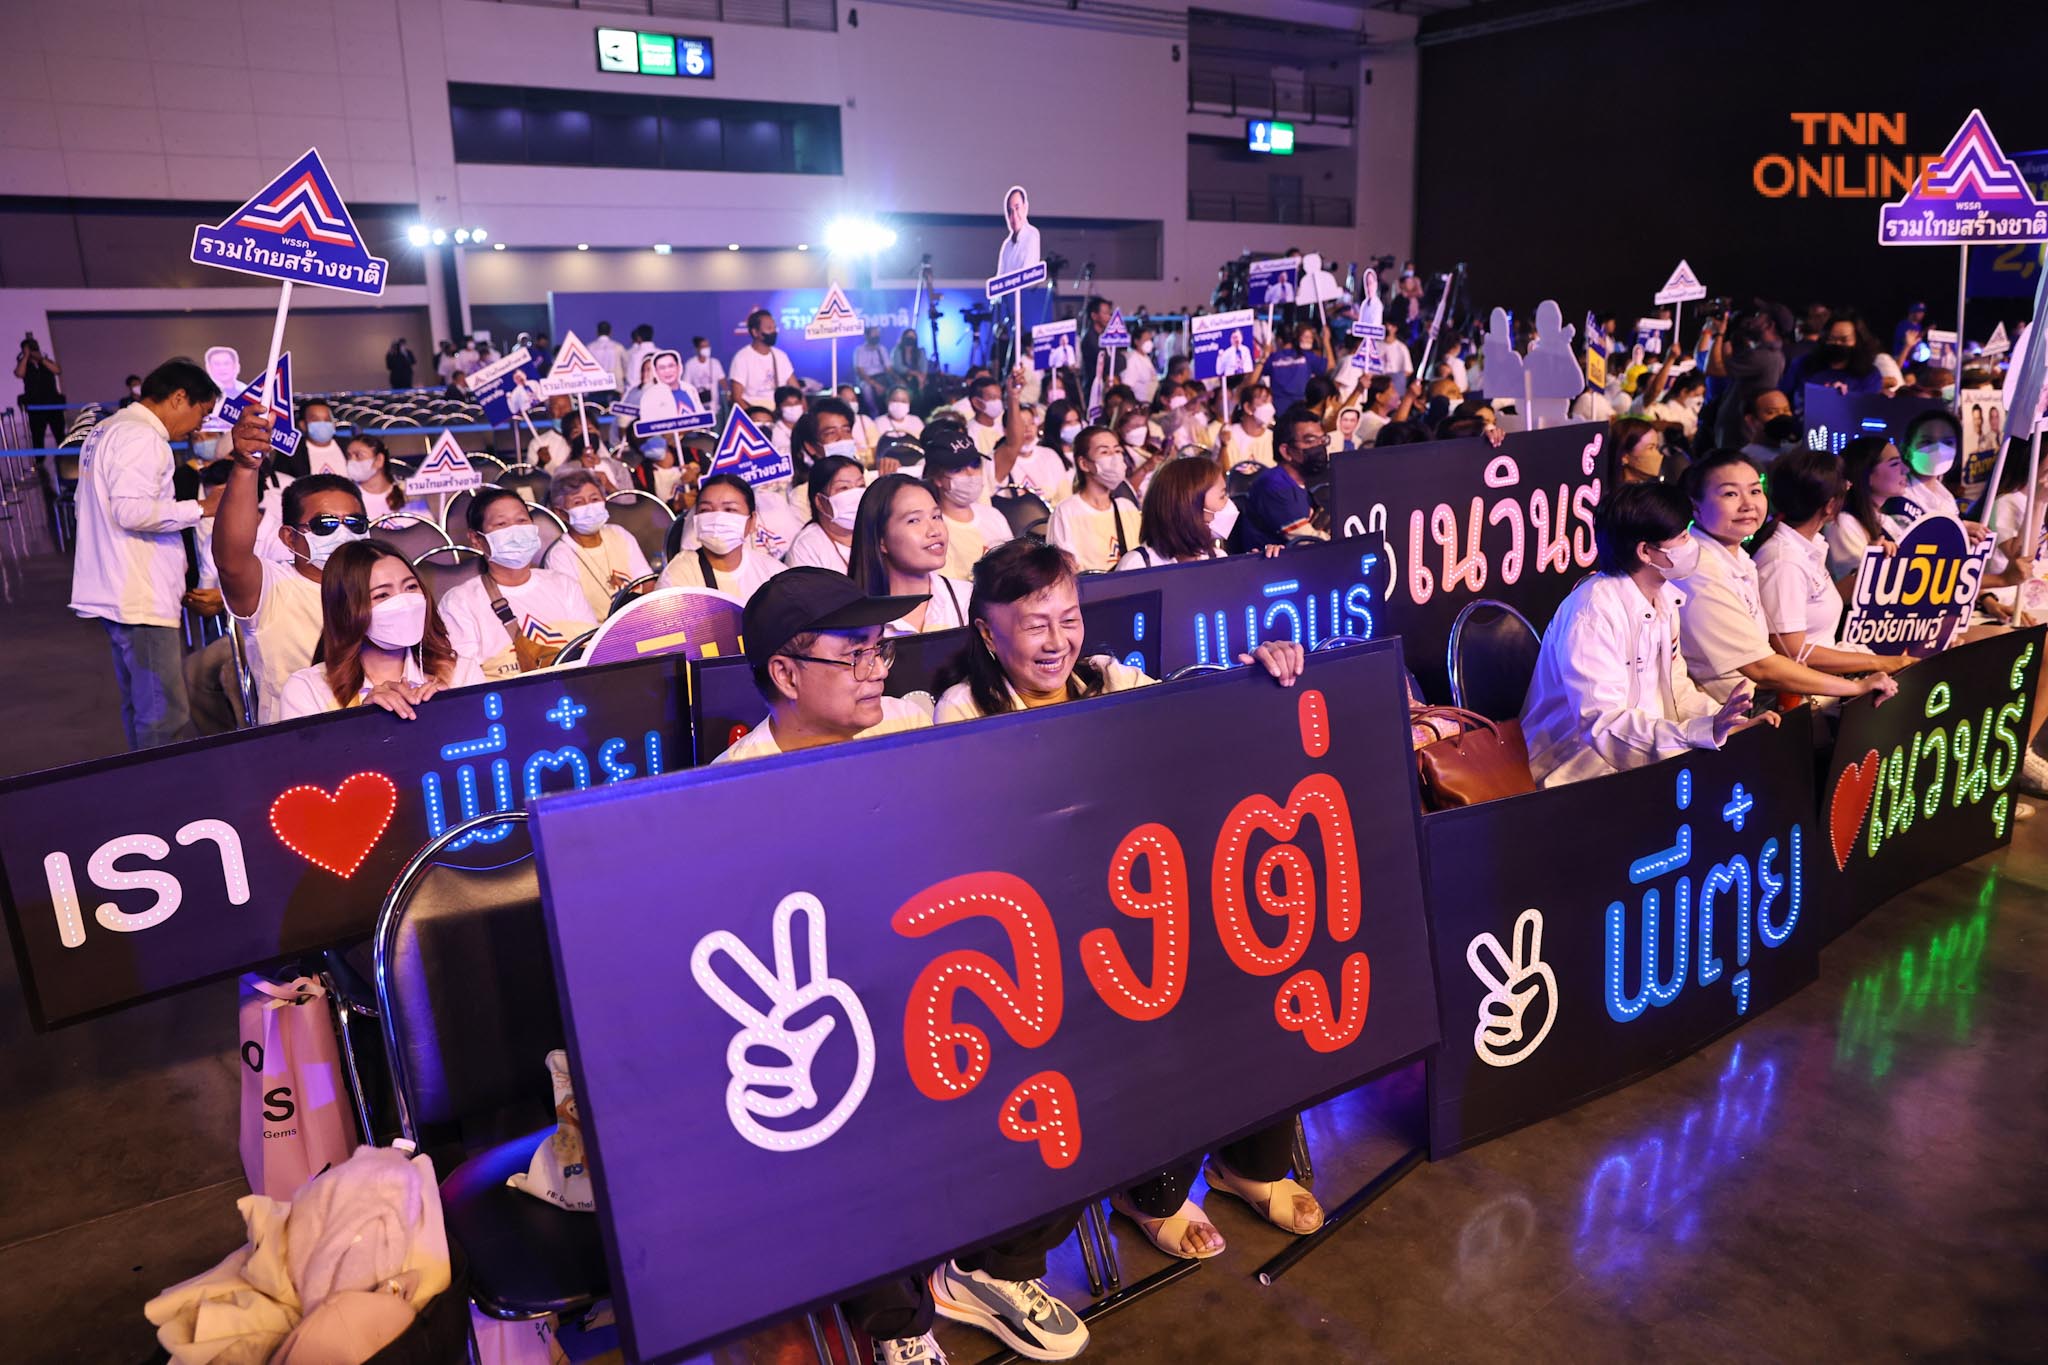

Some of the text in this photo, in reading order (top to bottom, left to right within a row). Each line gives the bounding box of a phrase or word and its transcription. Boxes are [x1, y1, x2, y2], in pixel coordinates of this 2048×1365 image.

[686, 48, 704, 75] 5
[1886, 210, 2048, 237] รวมไทยสร้างชาติ
[1955, 202, 1982, 210] พรรค
[200, 237, 381, 285] รวมไทยสร้างชาติ
[281, 236, 310, 249] พรรค
[1408, 433, 1603, 604] เนวินธ์
[44, 819, 250, 948] เรา
[1605, 768, 1802, 1023] พี่ตุ๋ย
[891, 690, 1370, 1169] ลุงตู่
[263, 1128, 297, 1139] Gems
